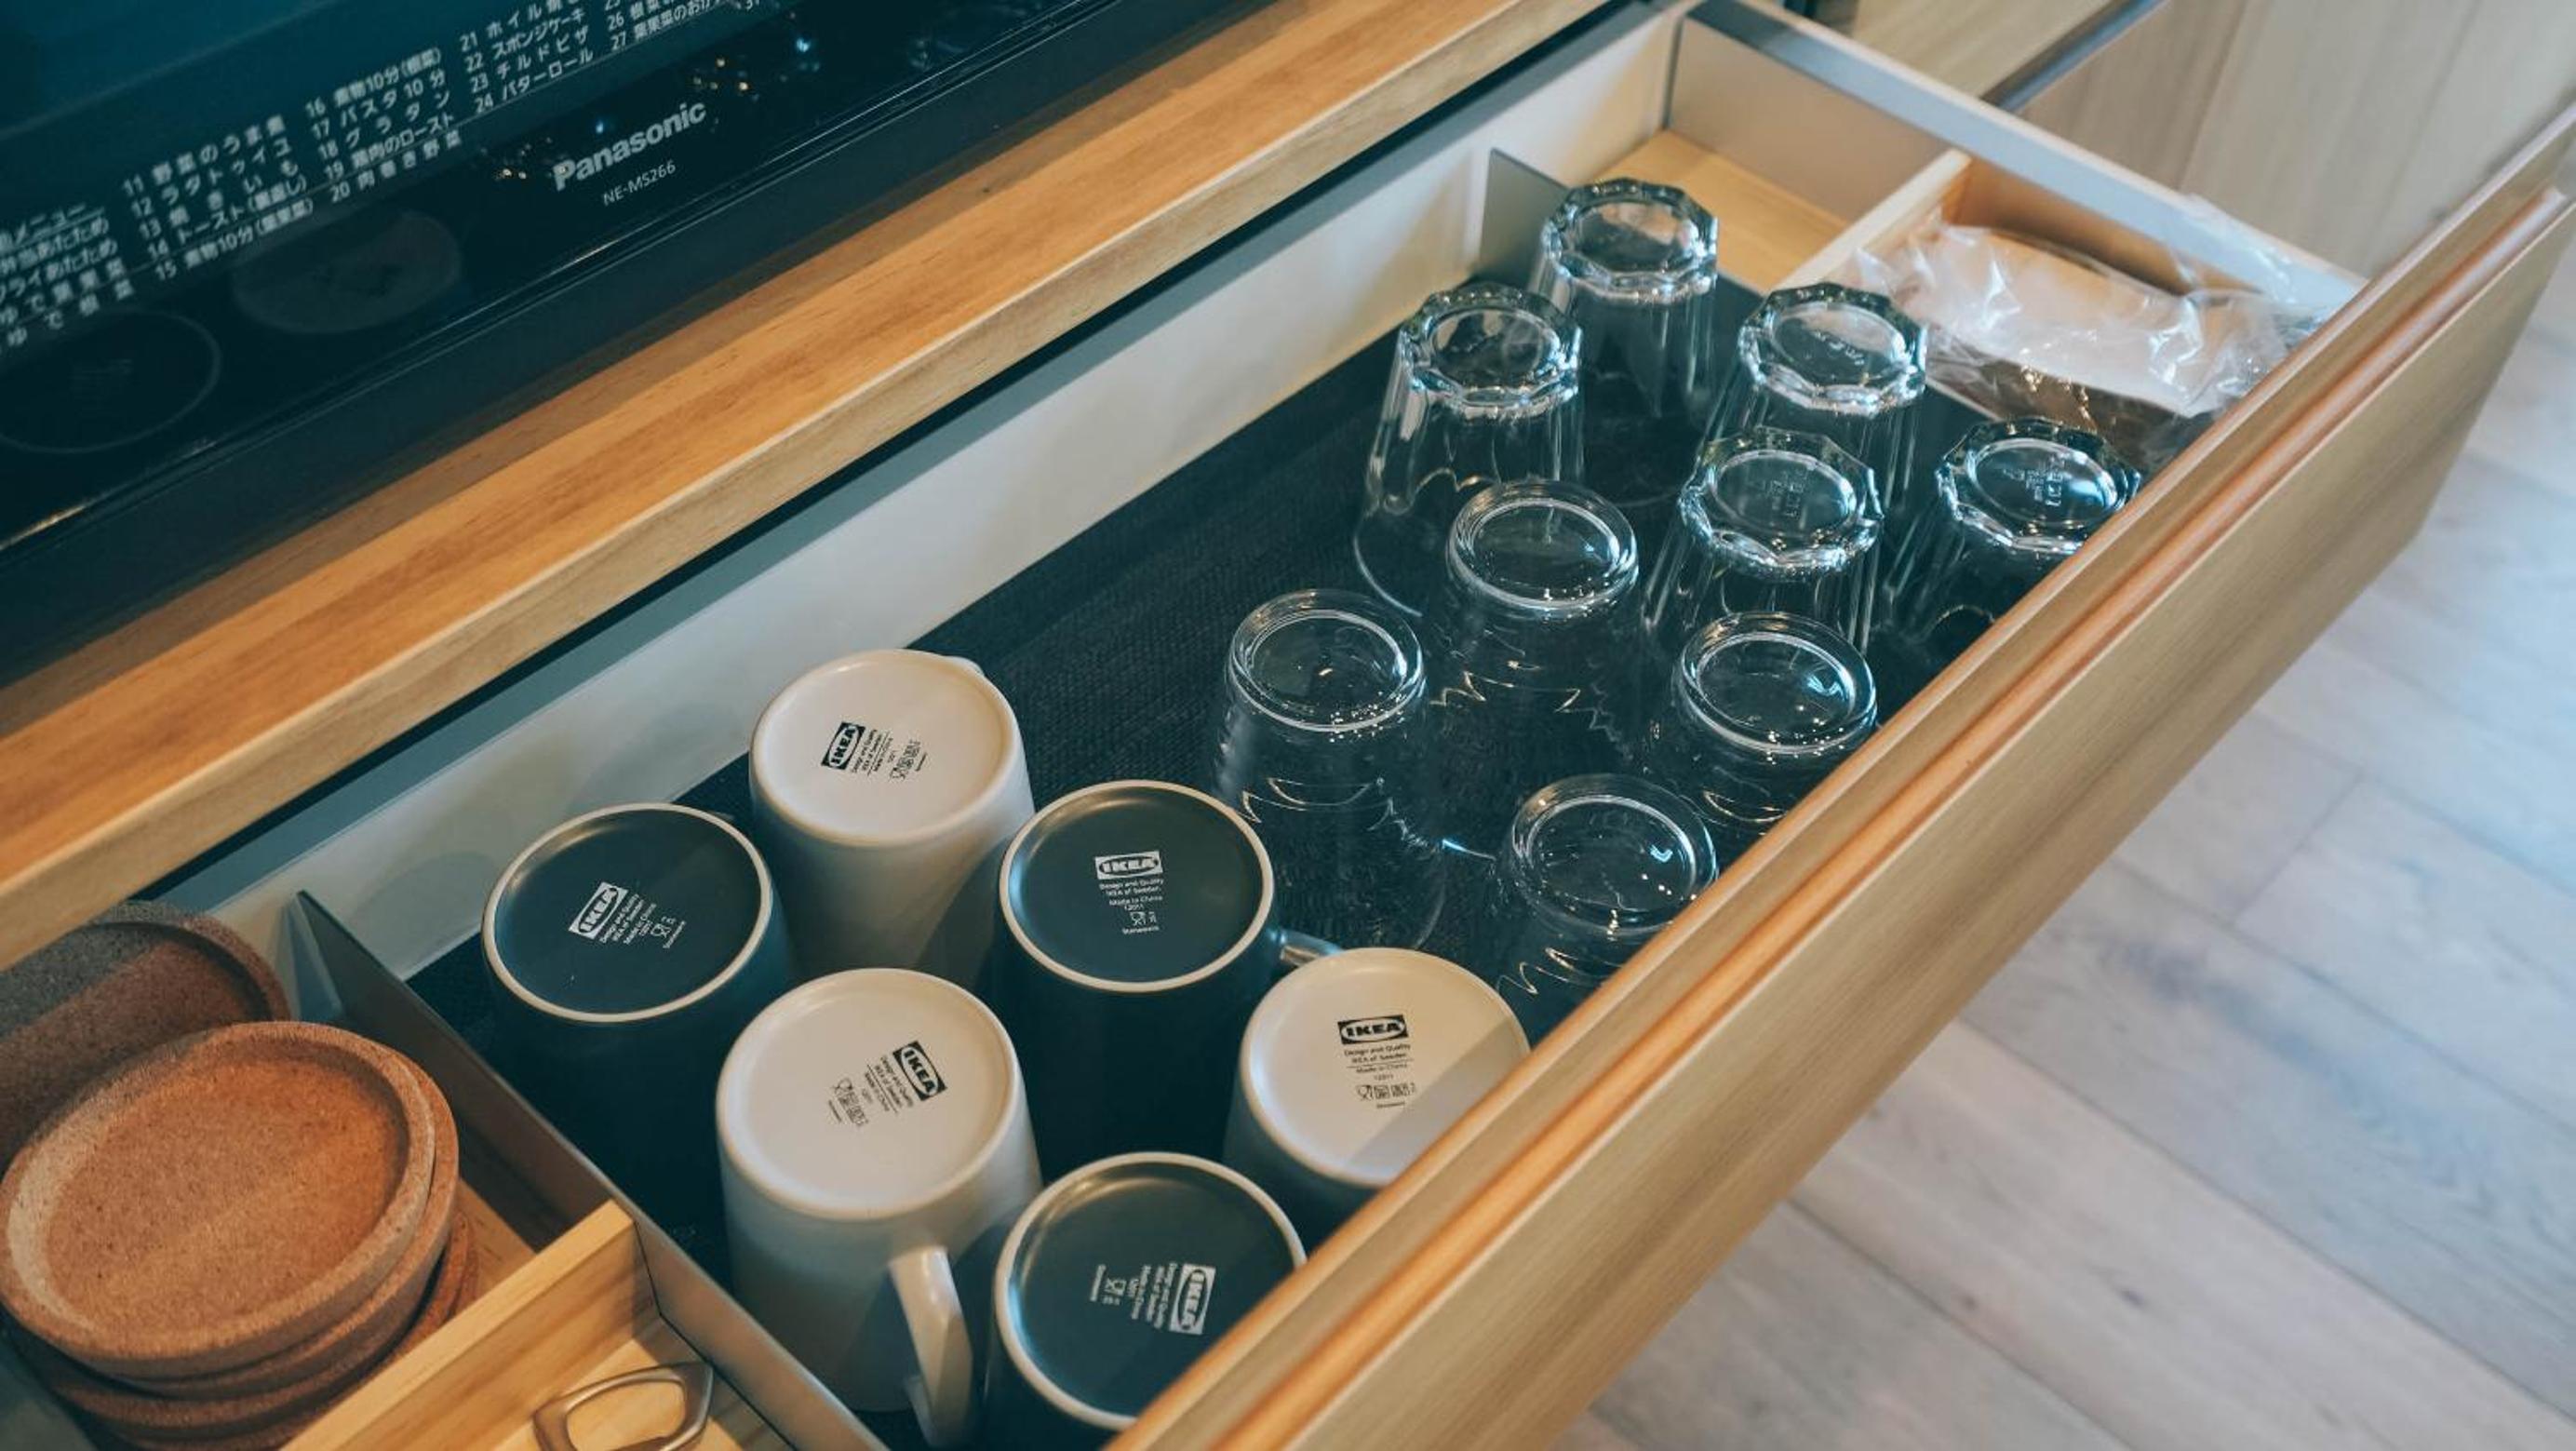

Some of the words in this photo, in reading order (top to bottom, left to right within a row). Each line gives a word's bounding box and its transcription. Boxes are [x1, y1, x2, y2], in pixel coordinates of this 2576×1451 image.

[608, 11, 624, 31] 26
[460, 32, 477, 52] 21
[610, 32, 626, 49] 27
[465, 52, 484, 73] 22
[470, 73, 489, 92] 23
[305, 97, 327, 117] 16
[475, 93, 493, 114] 24
[312, 117, 329, 140] 17
[318, 140, 339, 160] 18
[553, 102, 706, 192] Panasonic
[325, 159, 344, 180] 19
[123, 174, 144, 196] 11
[329, 181, 351, 203] 20
[604, 159, 677, 206] NE-MS266
[131, 196, 154, 218] 12
[139, 218, 161, 240] 13
[147, 237, 169, 259] 14
[154, 260, 177, 280] 15
[831, 729, 855, 763] IKEA
[1103, 858, 1154, 872] IKEA
[579, 889, 617, 931] IKEA
[1347, 1023, 1400, 1036] IKEA
[905, 1050, 934, 1091] IKEA
[1182, 1273, 1204, 1325] IKEA
